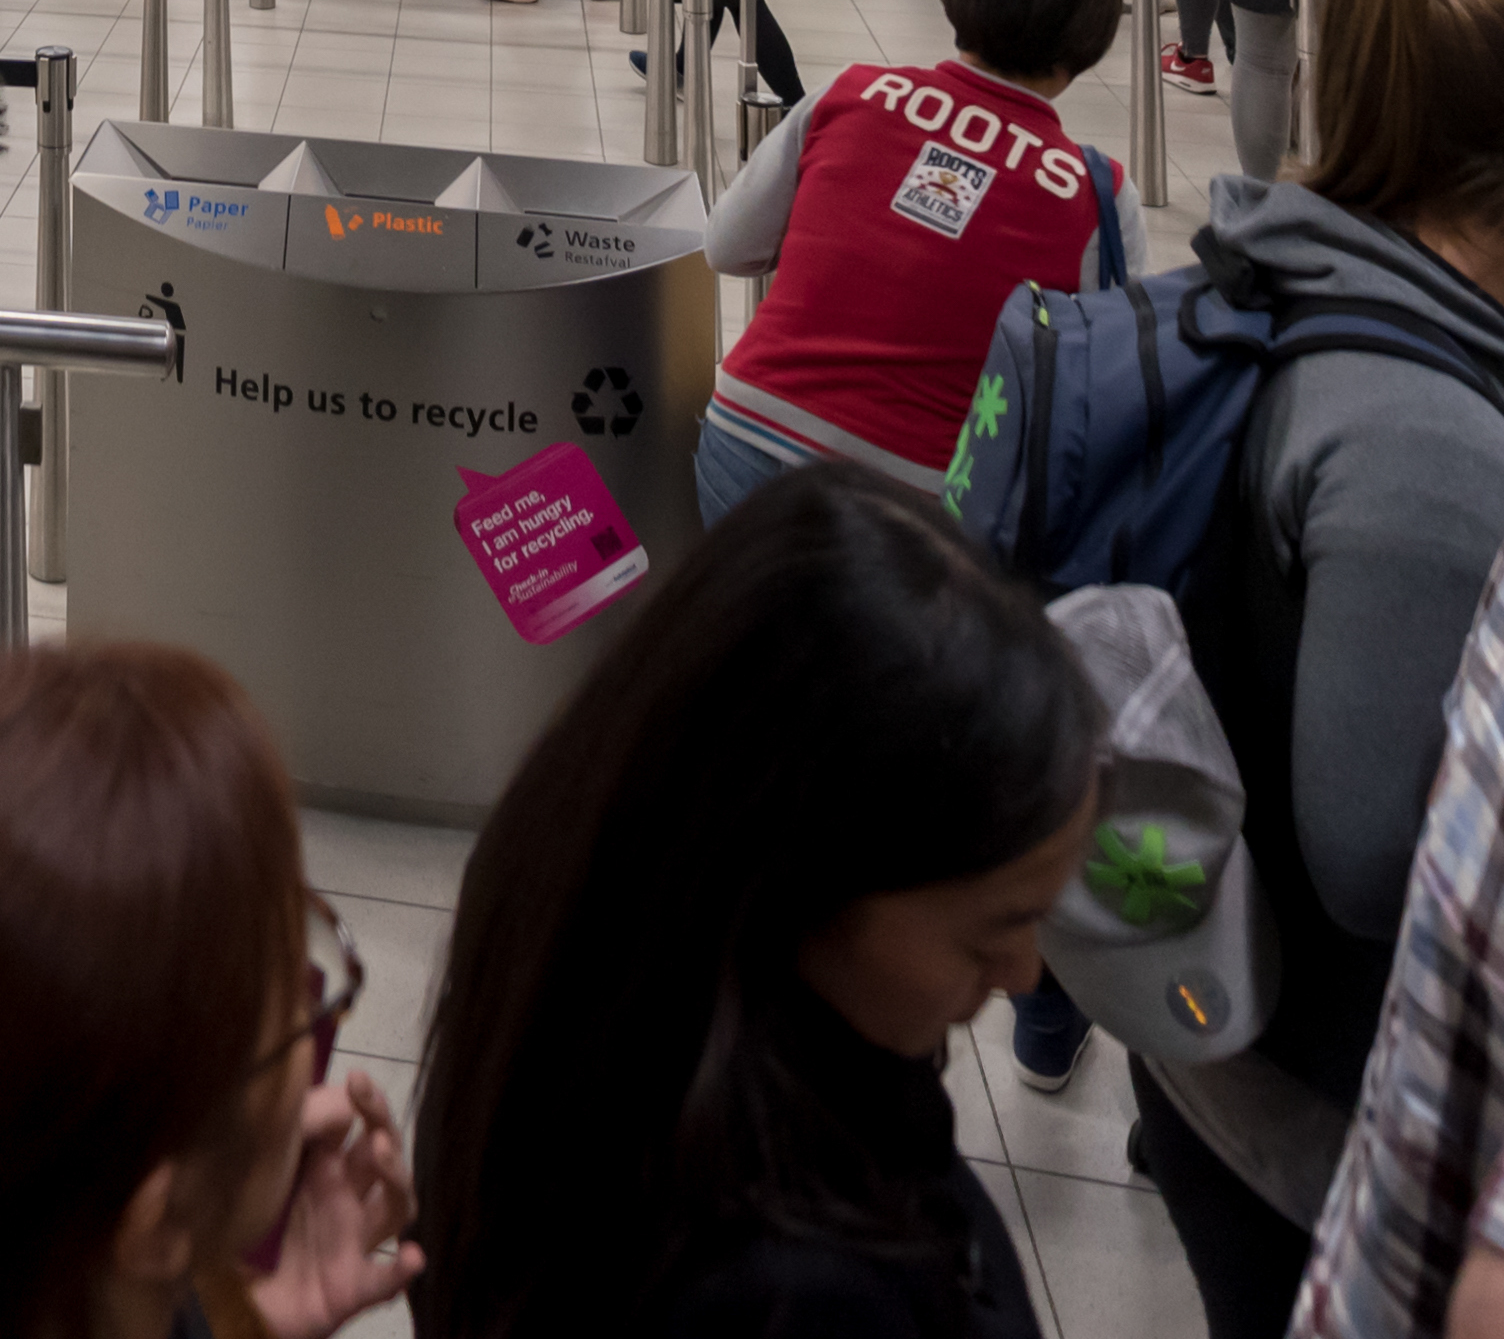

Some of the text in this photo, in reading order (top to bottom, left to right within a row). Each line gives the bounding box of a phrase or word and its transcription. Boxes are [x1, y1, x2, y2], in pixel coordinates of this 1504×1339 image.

[860, 73, 1087, 199] ROOTS
[923, 147, 987, 190] ROOTS
[188, 196, 249, 218] Paper
[903, 187, 964, 223] ATHLETICS
[186, 217, 229, 232] Papier
[372, 212, 444, 235] Plastic
[565, 230, 636, 254] Waste
[565, 250, 632, 270] Restafval
[215, 367, 538, 438] Help us to recycle
[471, 490, 545, 538] Feed me,
[481, 494, 572, 556] I am hungry
[494, 508, 594, 573] for recycling.
[509, 567, 549, 595] Check-in
